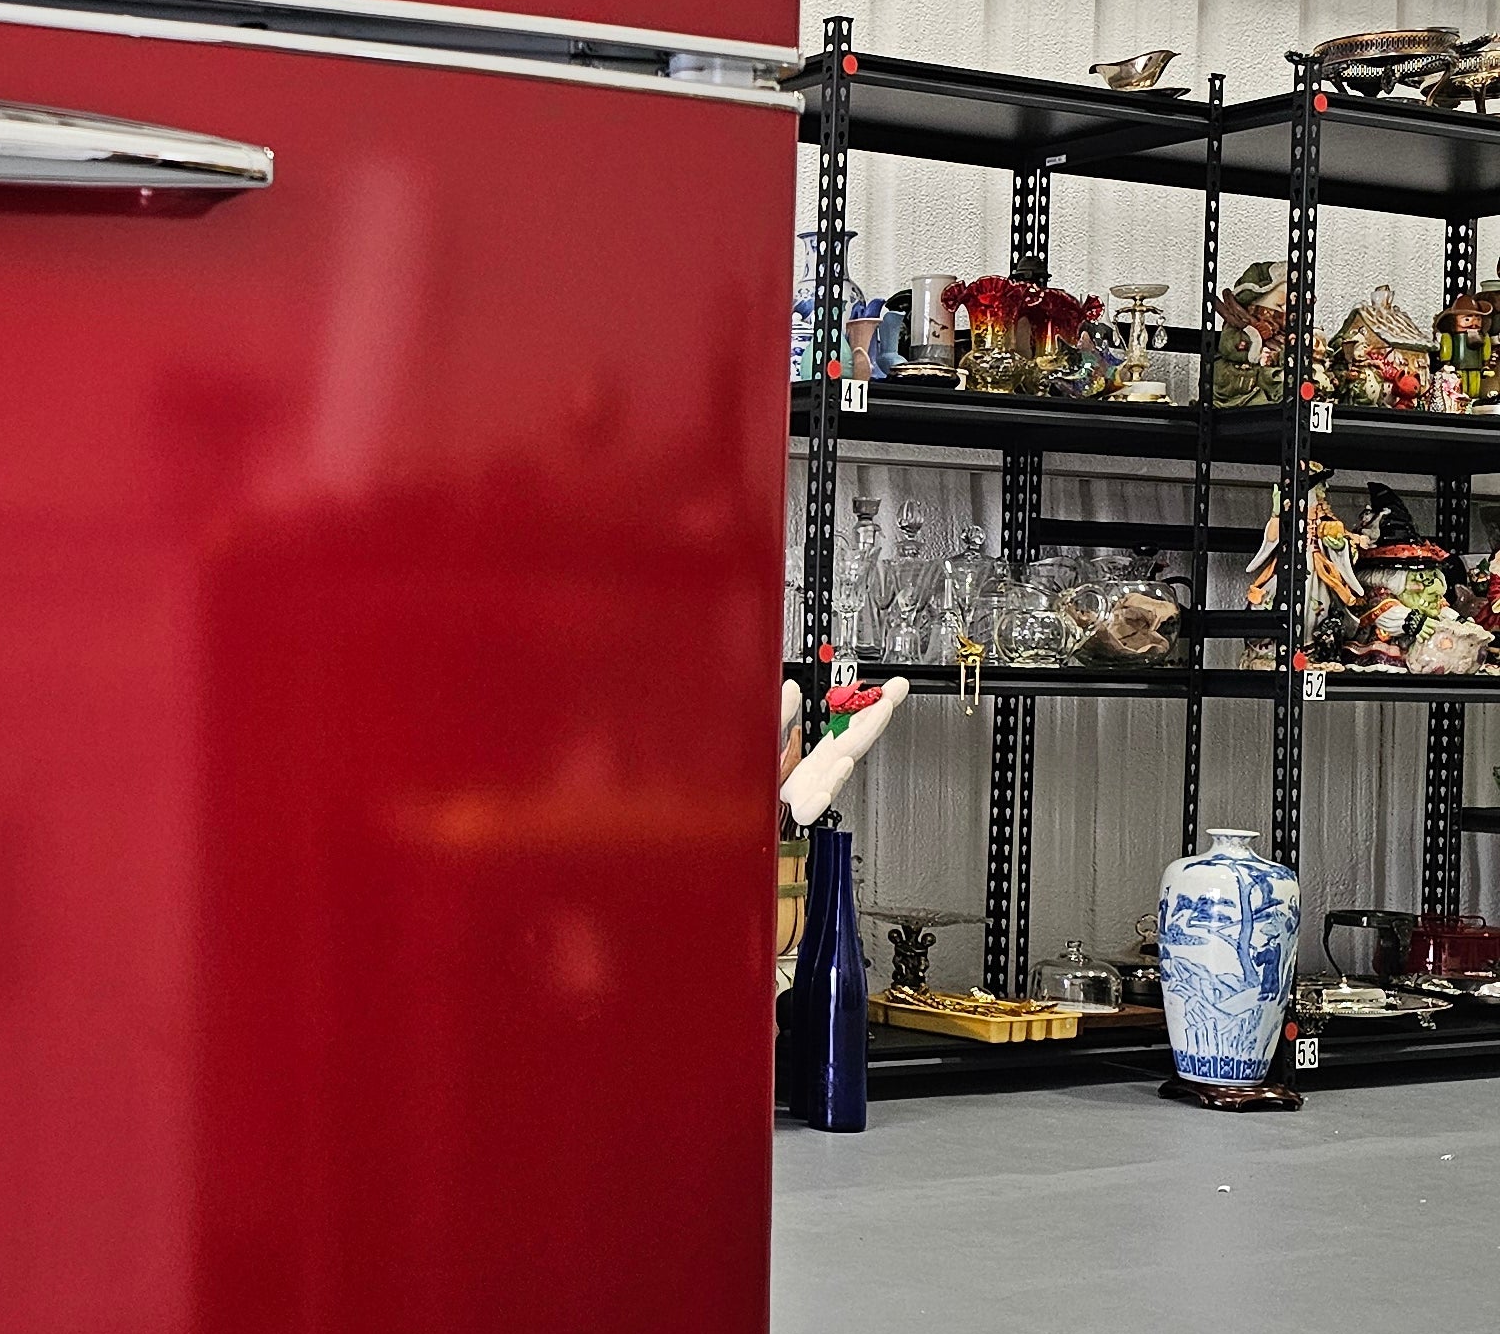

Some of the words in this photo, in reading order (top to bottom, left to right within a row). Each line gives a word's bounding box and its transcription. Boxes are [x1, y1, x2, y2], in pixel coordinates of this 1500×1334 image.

[844, 382, 864, 410] 41
[1312, 404, 1330, 431] 51
[834, 664, 855, 686] 42
[1305, 672, 1324, 698] 52
[1297, 1040, 1317, 1066] 53
